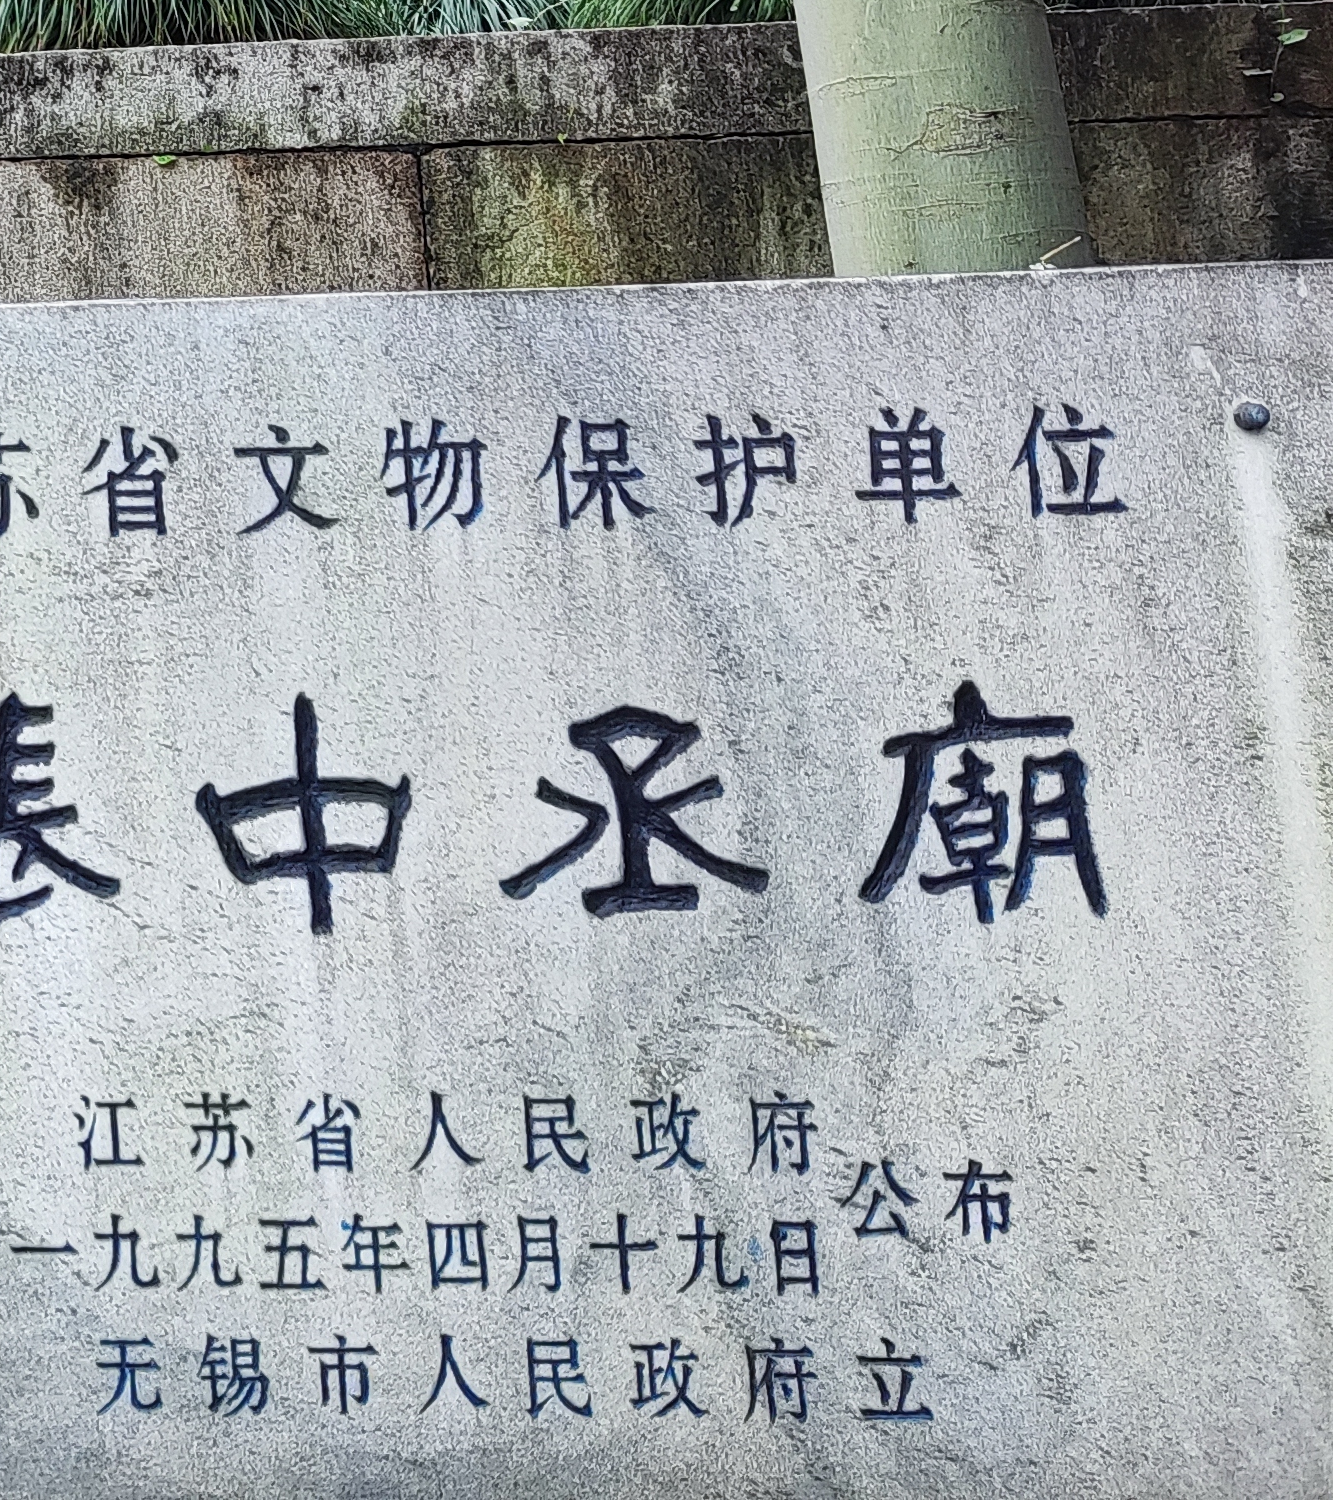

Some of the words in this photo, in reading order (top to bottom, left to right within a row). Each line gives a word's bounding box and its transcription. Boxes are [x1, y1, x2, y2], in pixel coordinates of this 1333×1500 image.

[72, 1090, 819, 1174] 江苏省人民政府
[837, 1158, 1014, 1243] 公布
[9, 1212, 822, 1296] 一九九五年四月十九日
[94, 1332, 934, 1422] 无锡市人民政府立
